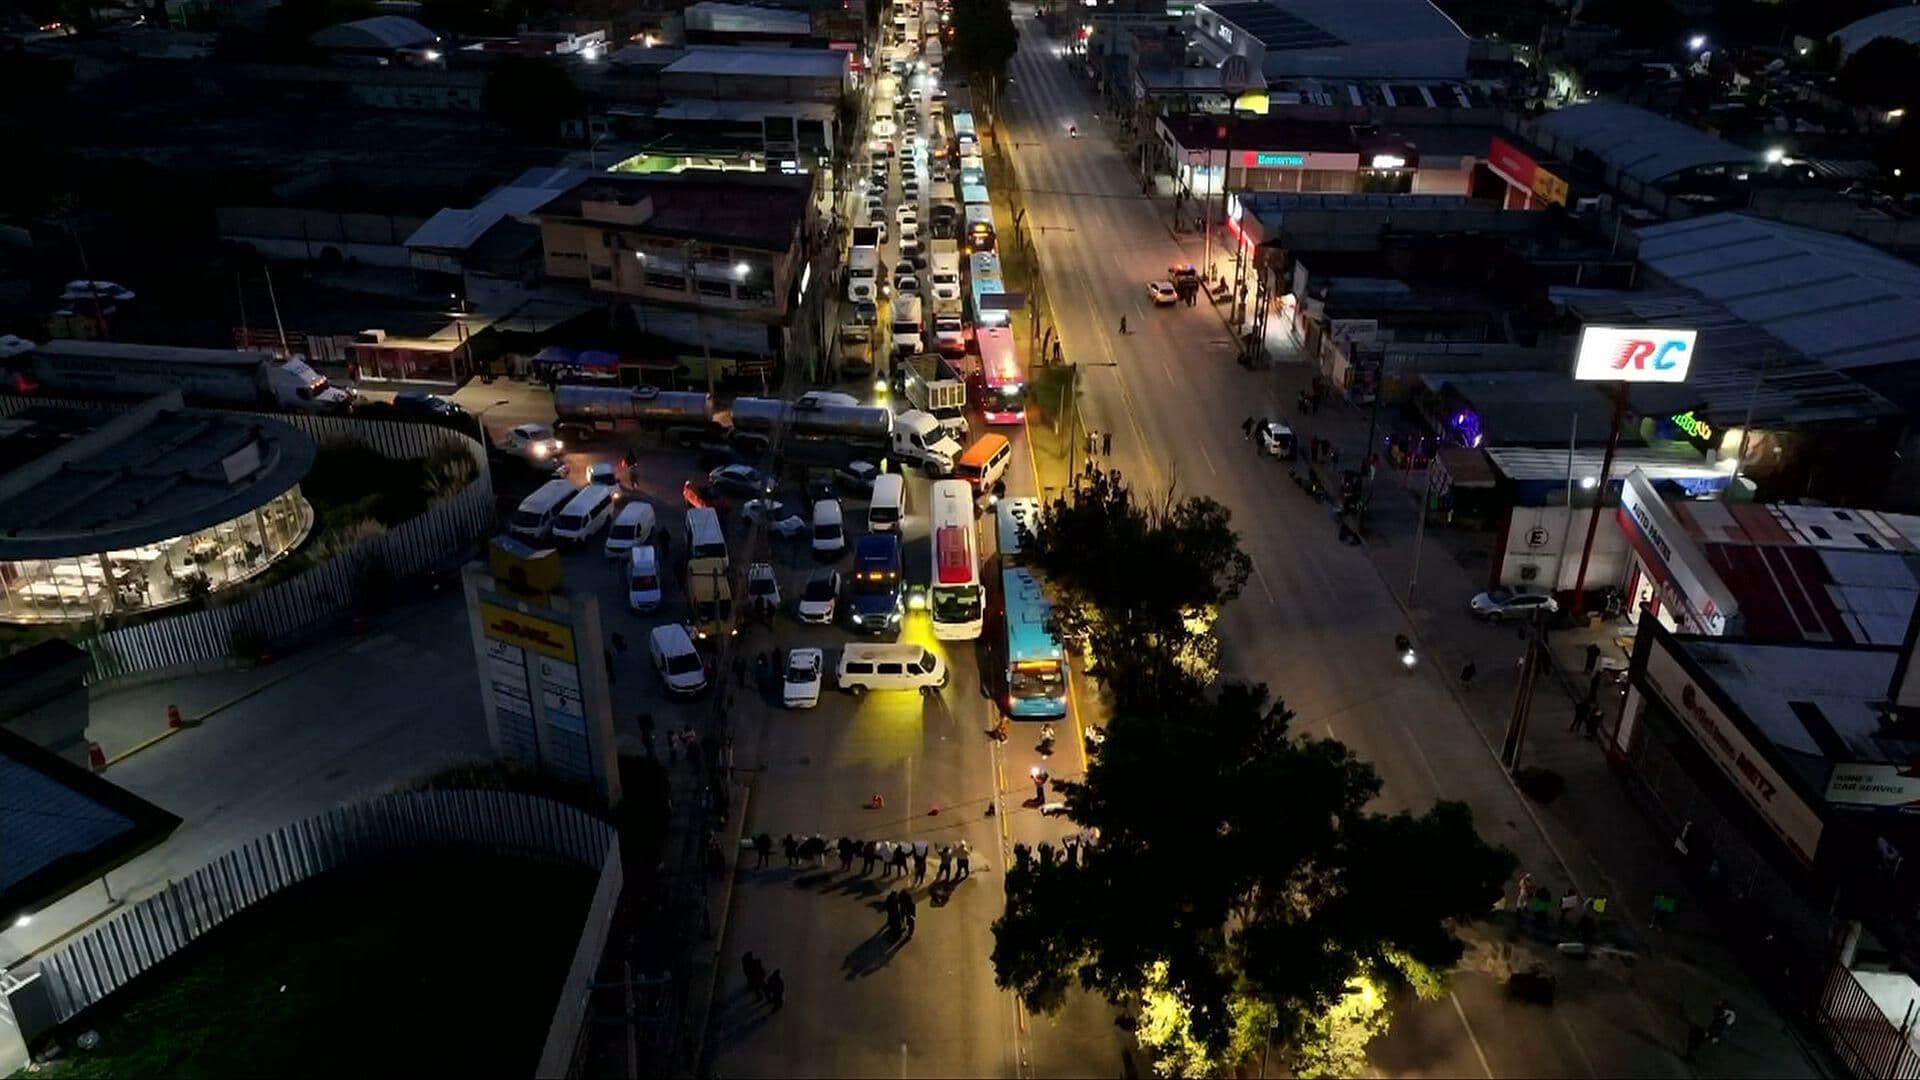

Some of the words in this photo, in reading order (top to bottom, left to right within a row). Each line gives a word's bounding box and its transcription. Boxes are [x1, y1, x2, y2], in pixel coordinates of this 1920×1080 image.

[1258, 154, 1304, 165] Banamex
[1612, 339, 1687, 370] RC
[1632, 502, 1649, 529] AUTO
[1531, 530, 1544, 545] E
[1832, 783, 1857, 791] CAR
